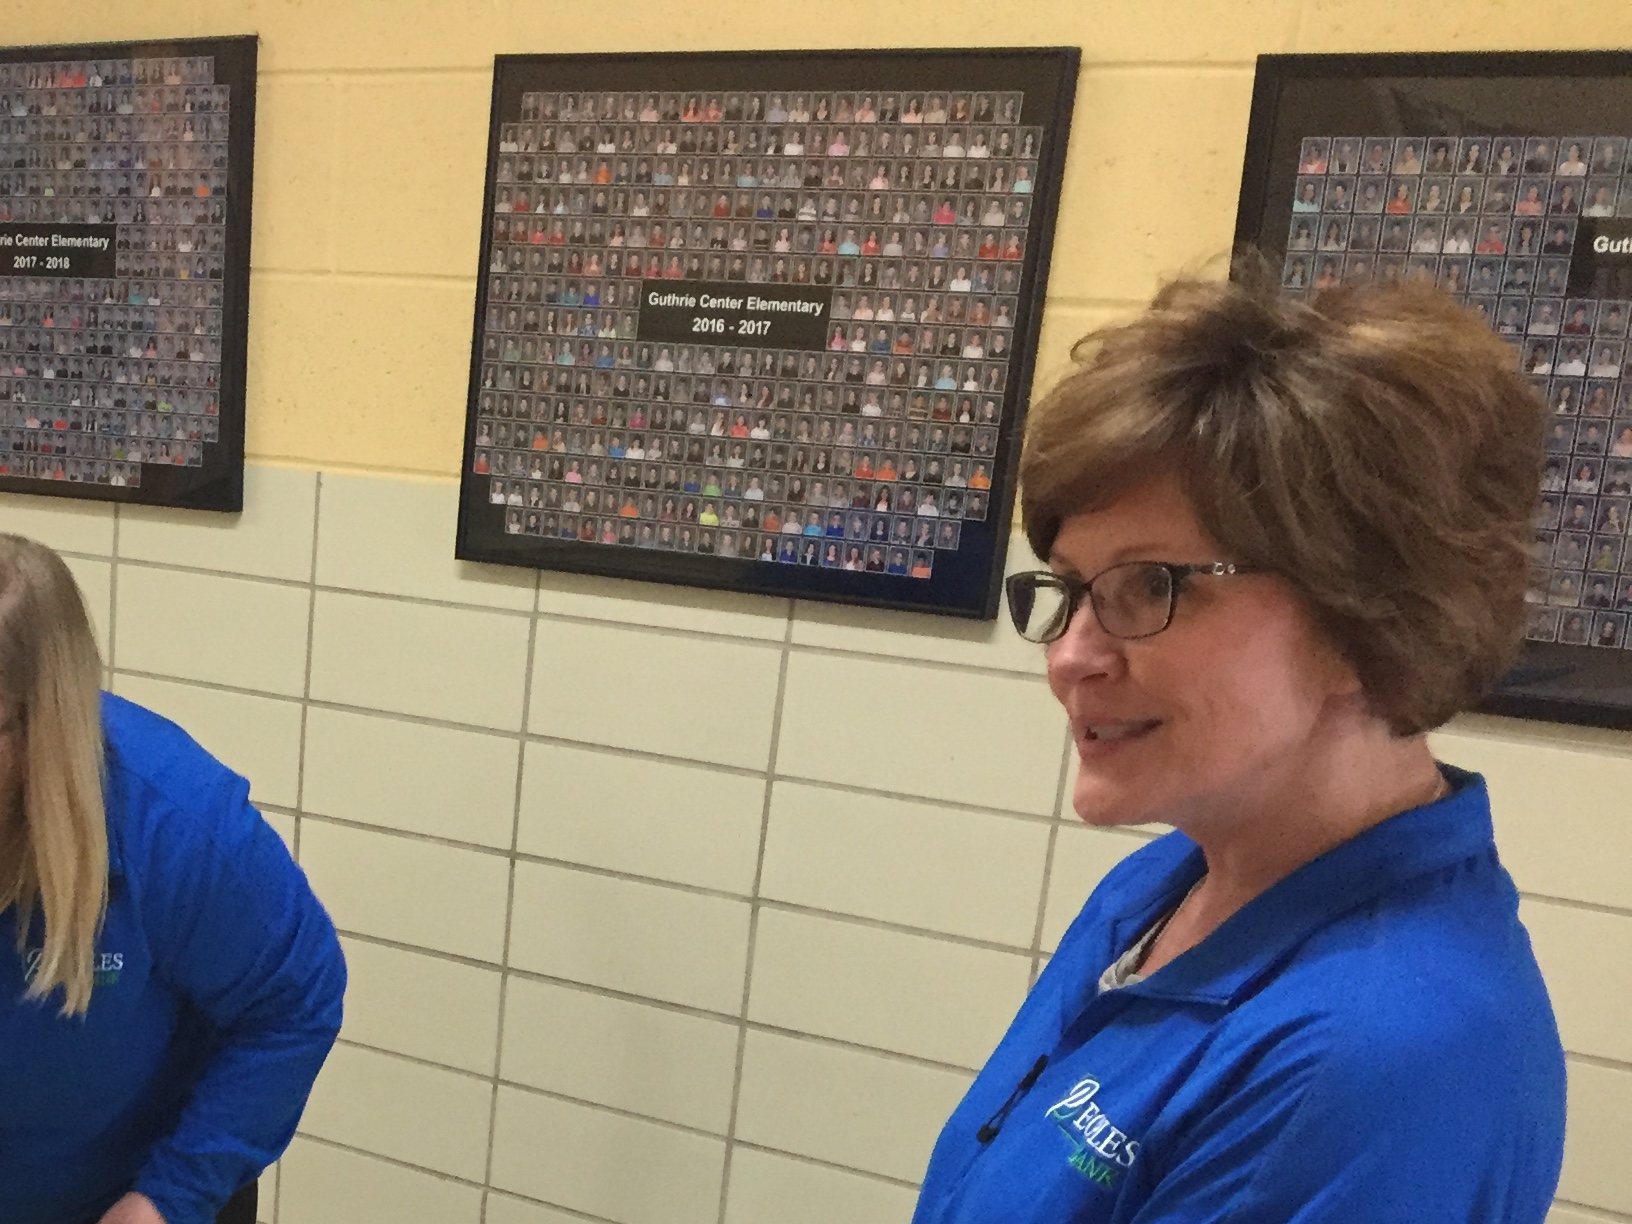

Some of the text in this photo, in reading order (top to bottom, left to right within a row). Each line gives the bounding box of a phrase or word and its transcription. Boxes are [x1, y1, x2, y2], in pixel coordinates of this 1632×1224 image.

[15, 233, 49, 247] Center
[51, 234, 110, 250] Elementary
[1593, 235, 1632, 254] Gut
[13, 255, 37, 268] 2017
[46, 256, 70, 269] 2018
[648, 291, 824, 316] Guthrie Center Elementary
[692, 317, 725, 334] 2016
[738, 319, 772, 336] 2017
